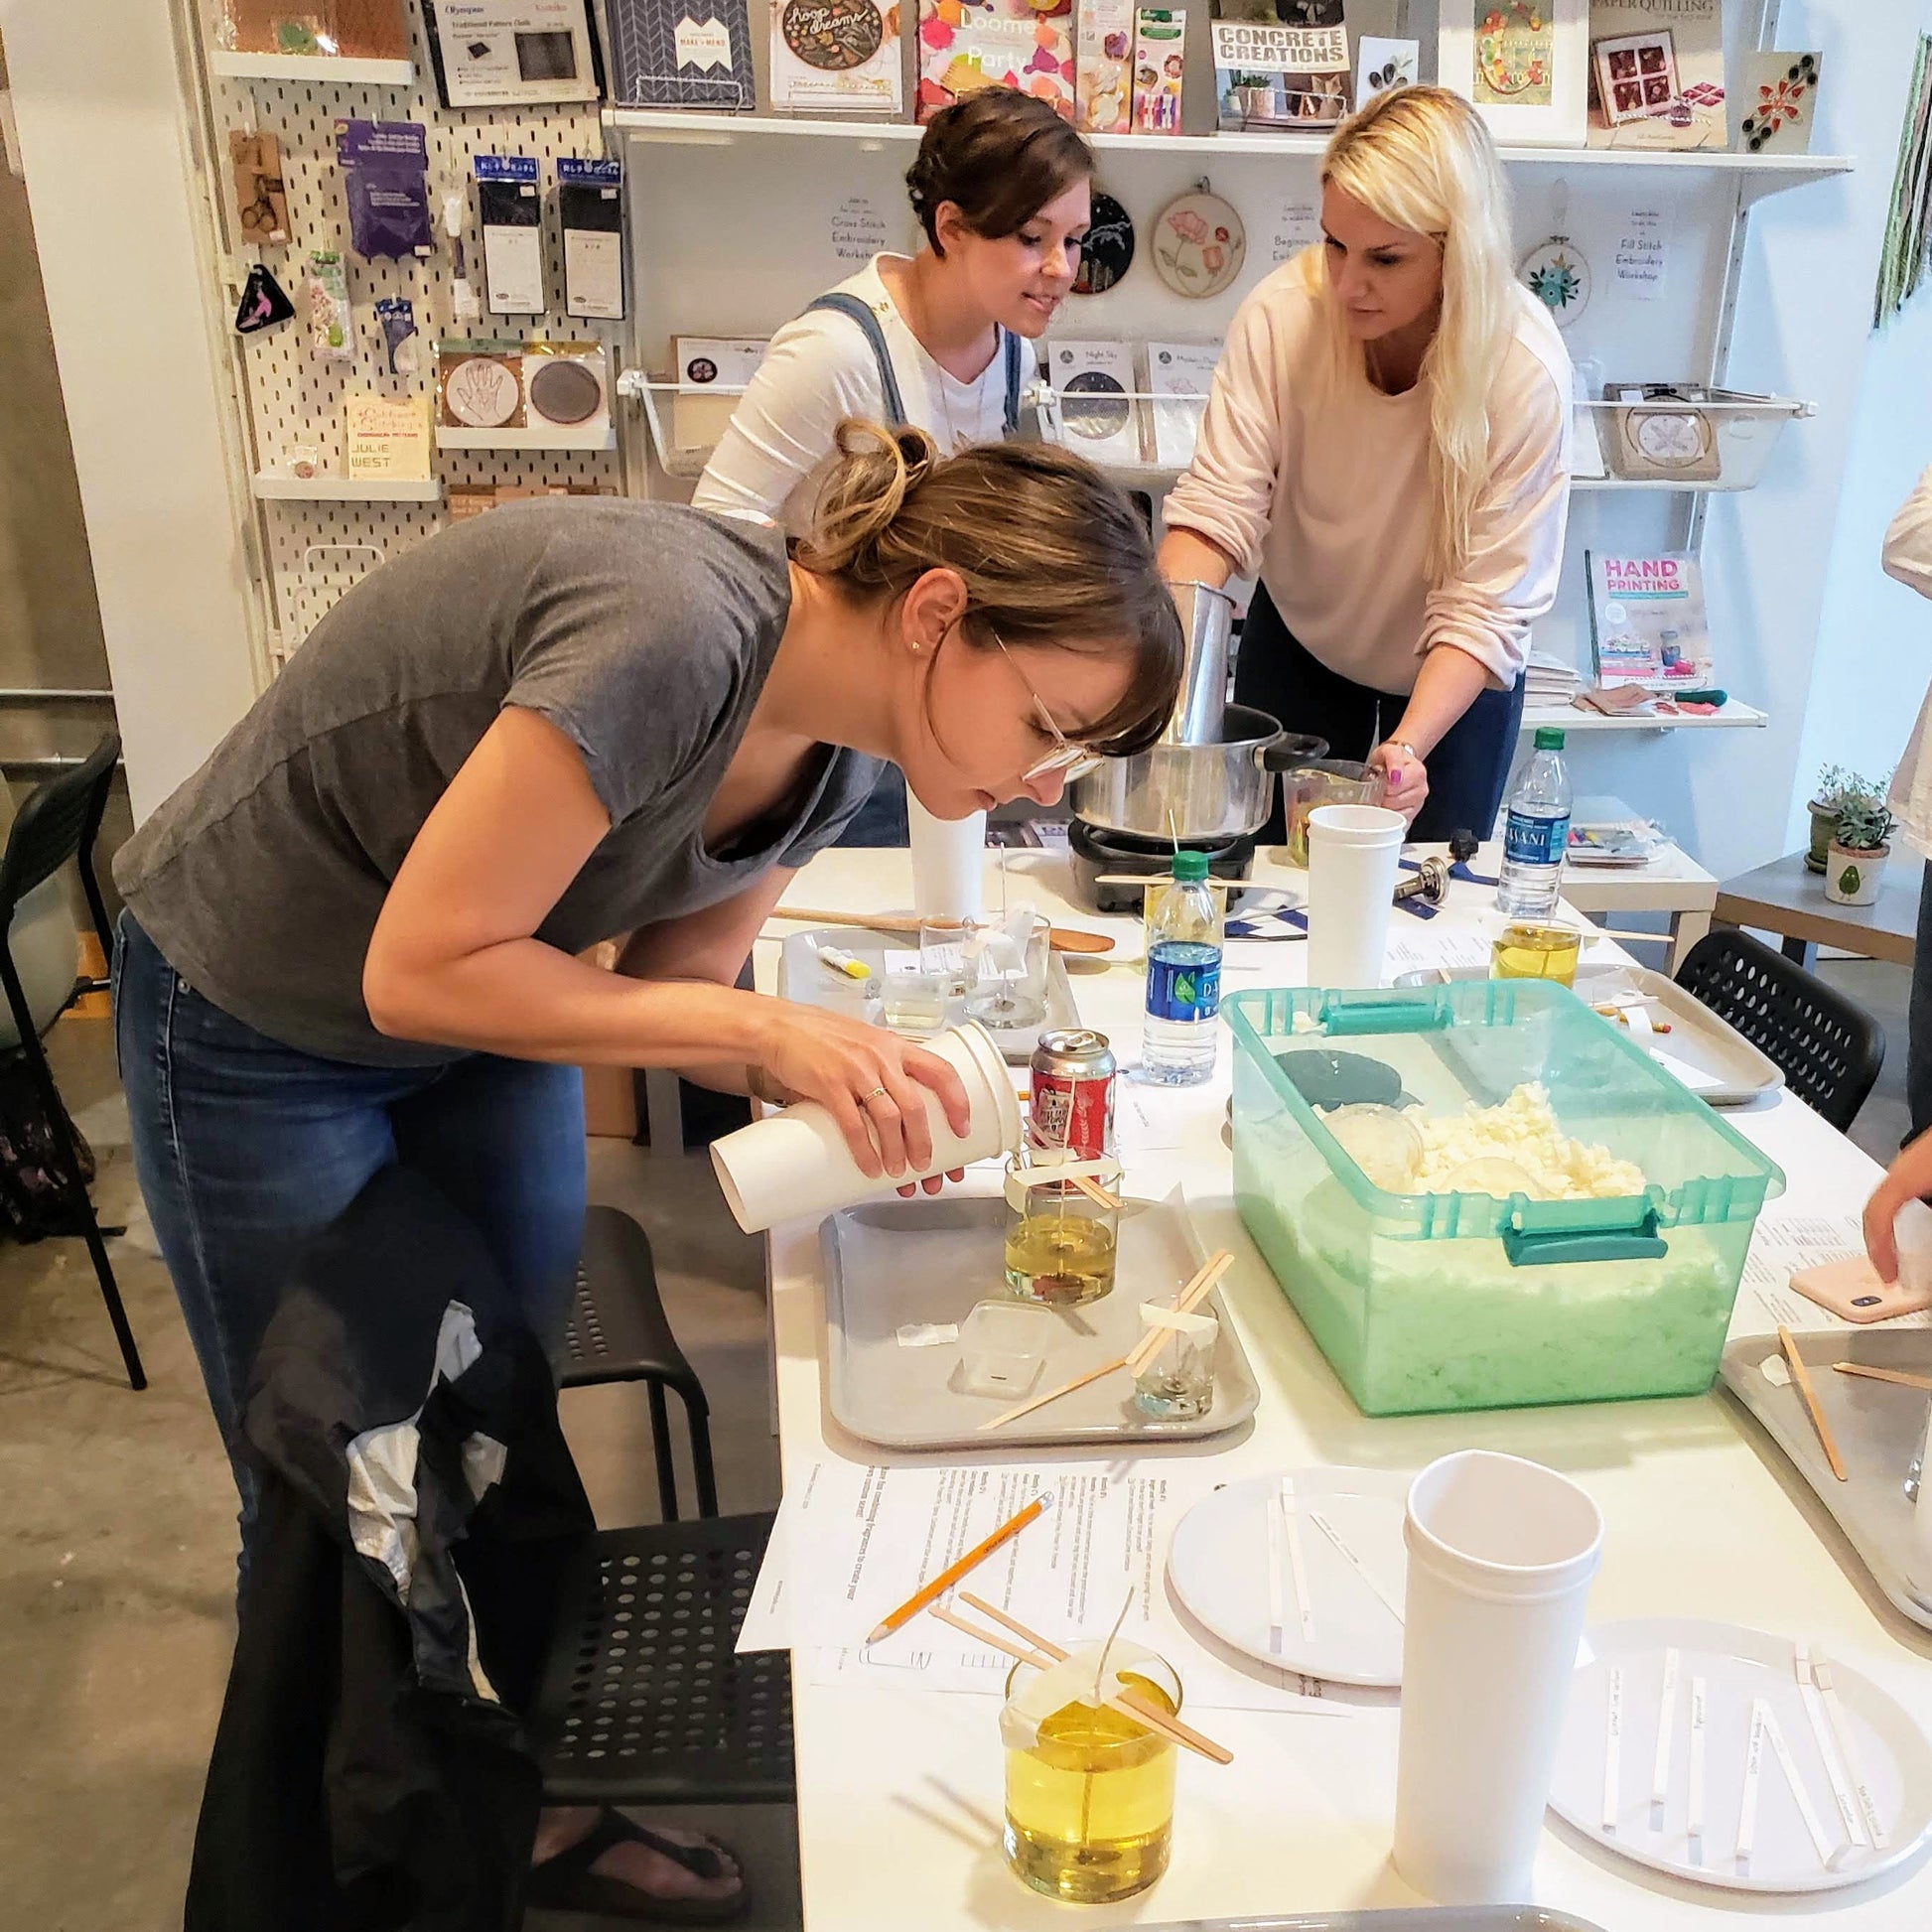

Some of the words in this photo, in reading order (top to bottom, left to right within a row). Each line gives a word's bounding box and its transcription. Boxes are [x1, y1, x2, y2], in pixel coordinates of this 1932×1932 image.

[809, 9, 869, 34] dreams
[1218, 28, 1342, 47] CONCRETE
[1220, 45, 1343, 63] CREATIONS
[350, 444, 390, 454] JULIE
[350, 457, 391, 468] WEST
[1605, 559, 1678, 578] HAND
[1606, 579, 1680, 592] PRINTING
[857, 1521, 874, 1555] fragrances
[845, 1584, 856, 1600] your
